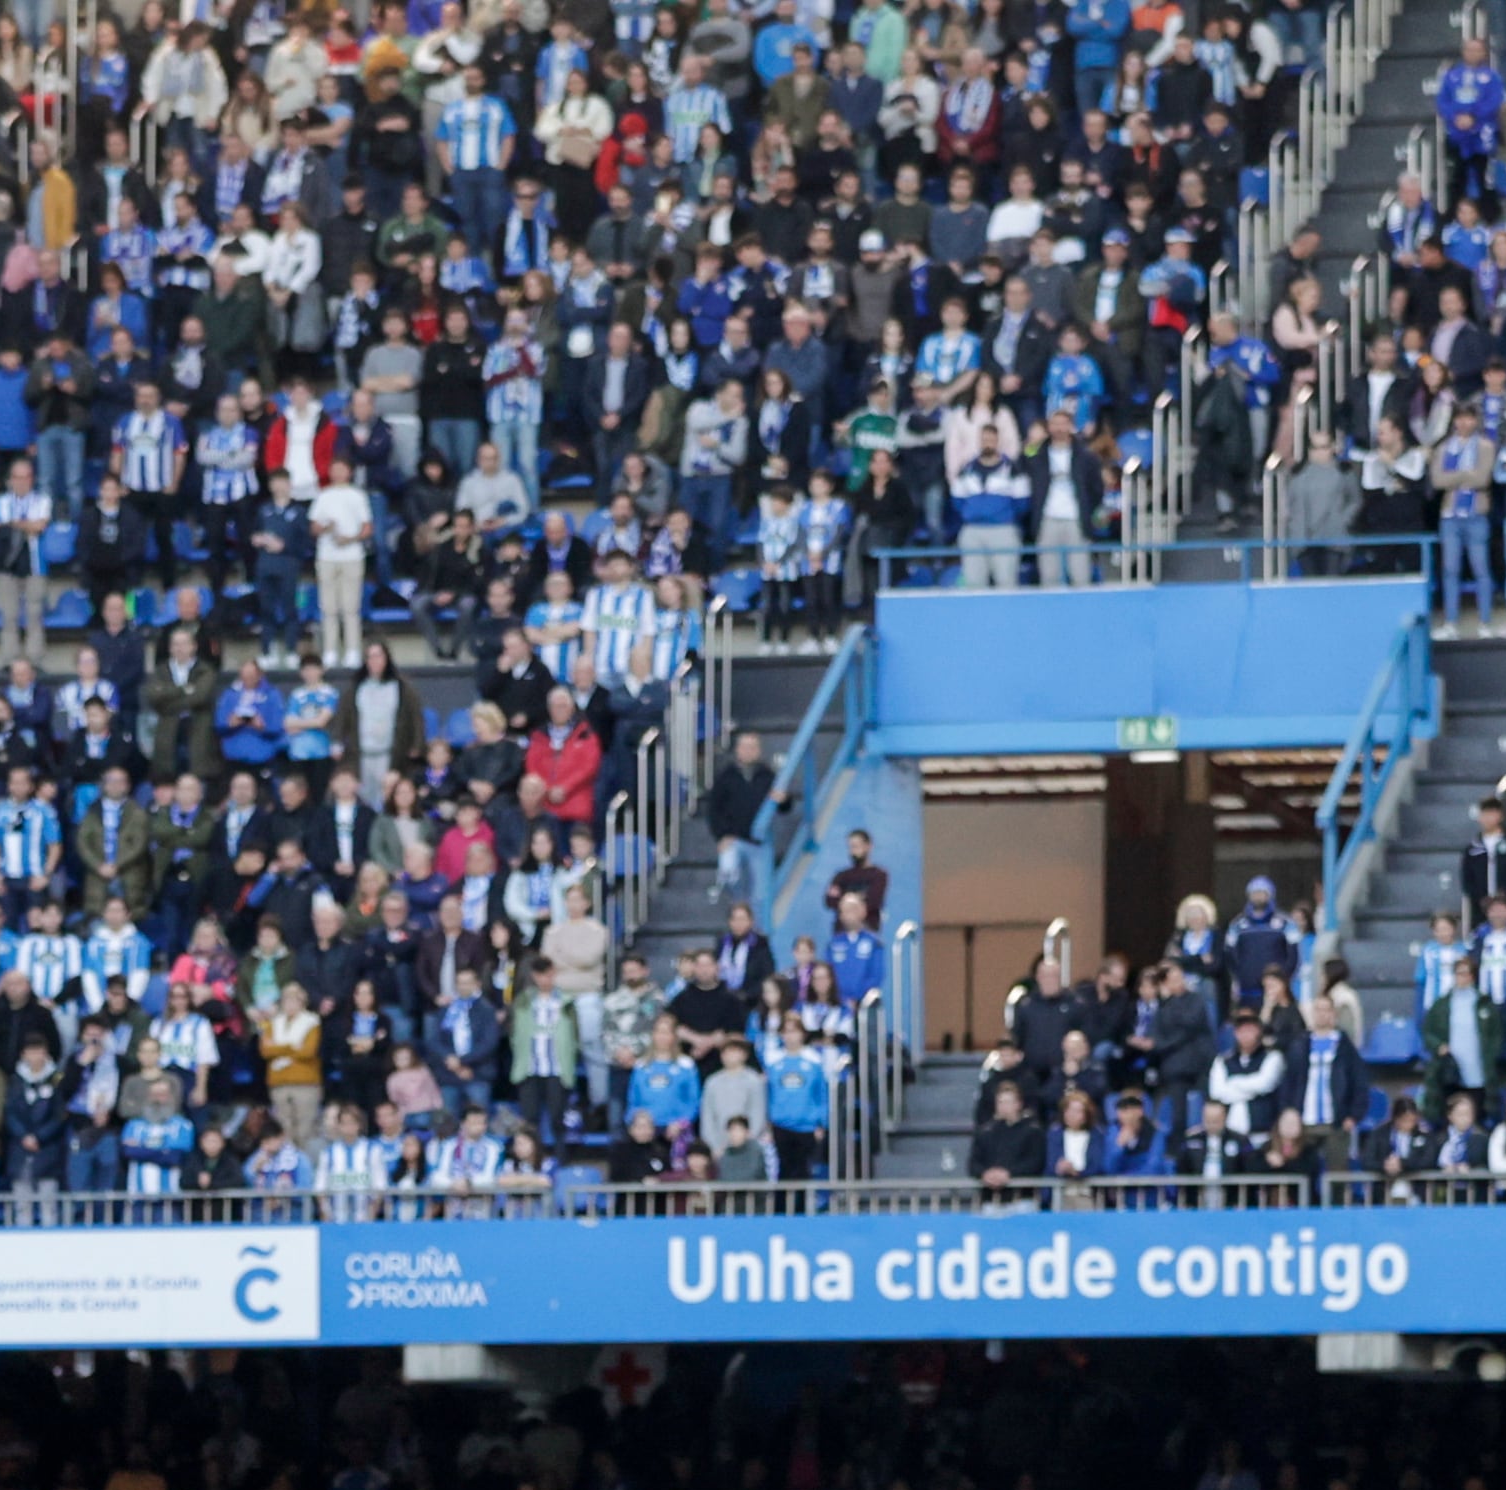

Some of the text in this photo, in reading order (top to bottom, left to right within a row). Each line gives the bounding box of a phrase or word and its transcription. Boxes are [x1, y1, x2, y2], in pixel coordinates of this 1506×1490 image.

[344, 1247, 463, 1279] CORUÑA
[667, 1227, 1410, 1312] Unha cidade contigo
